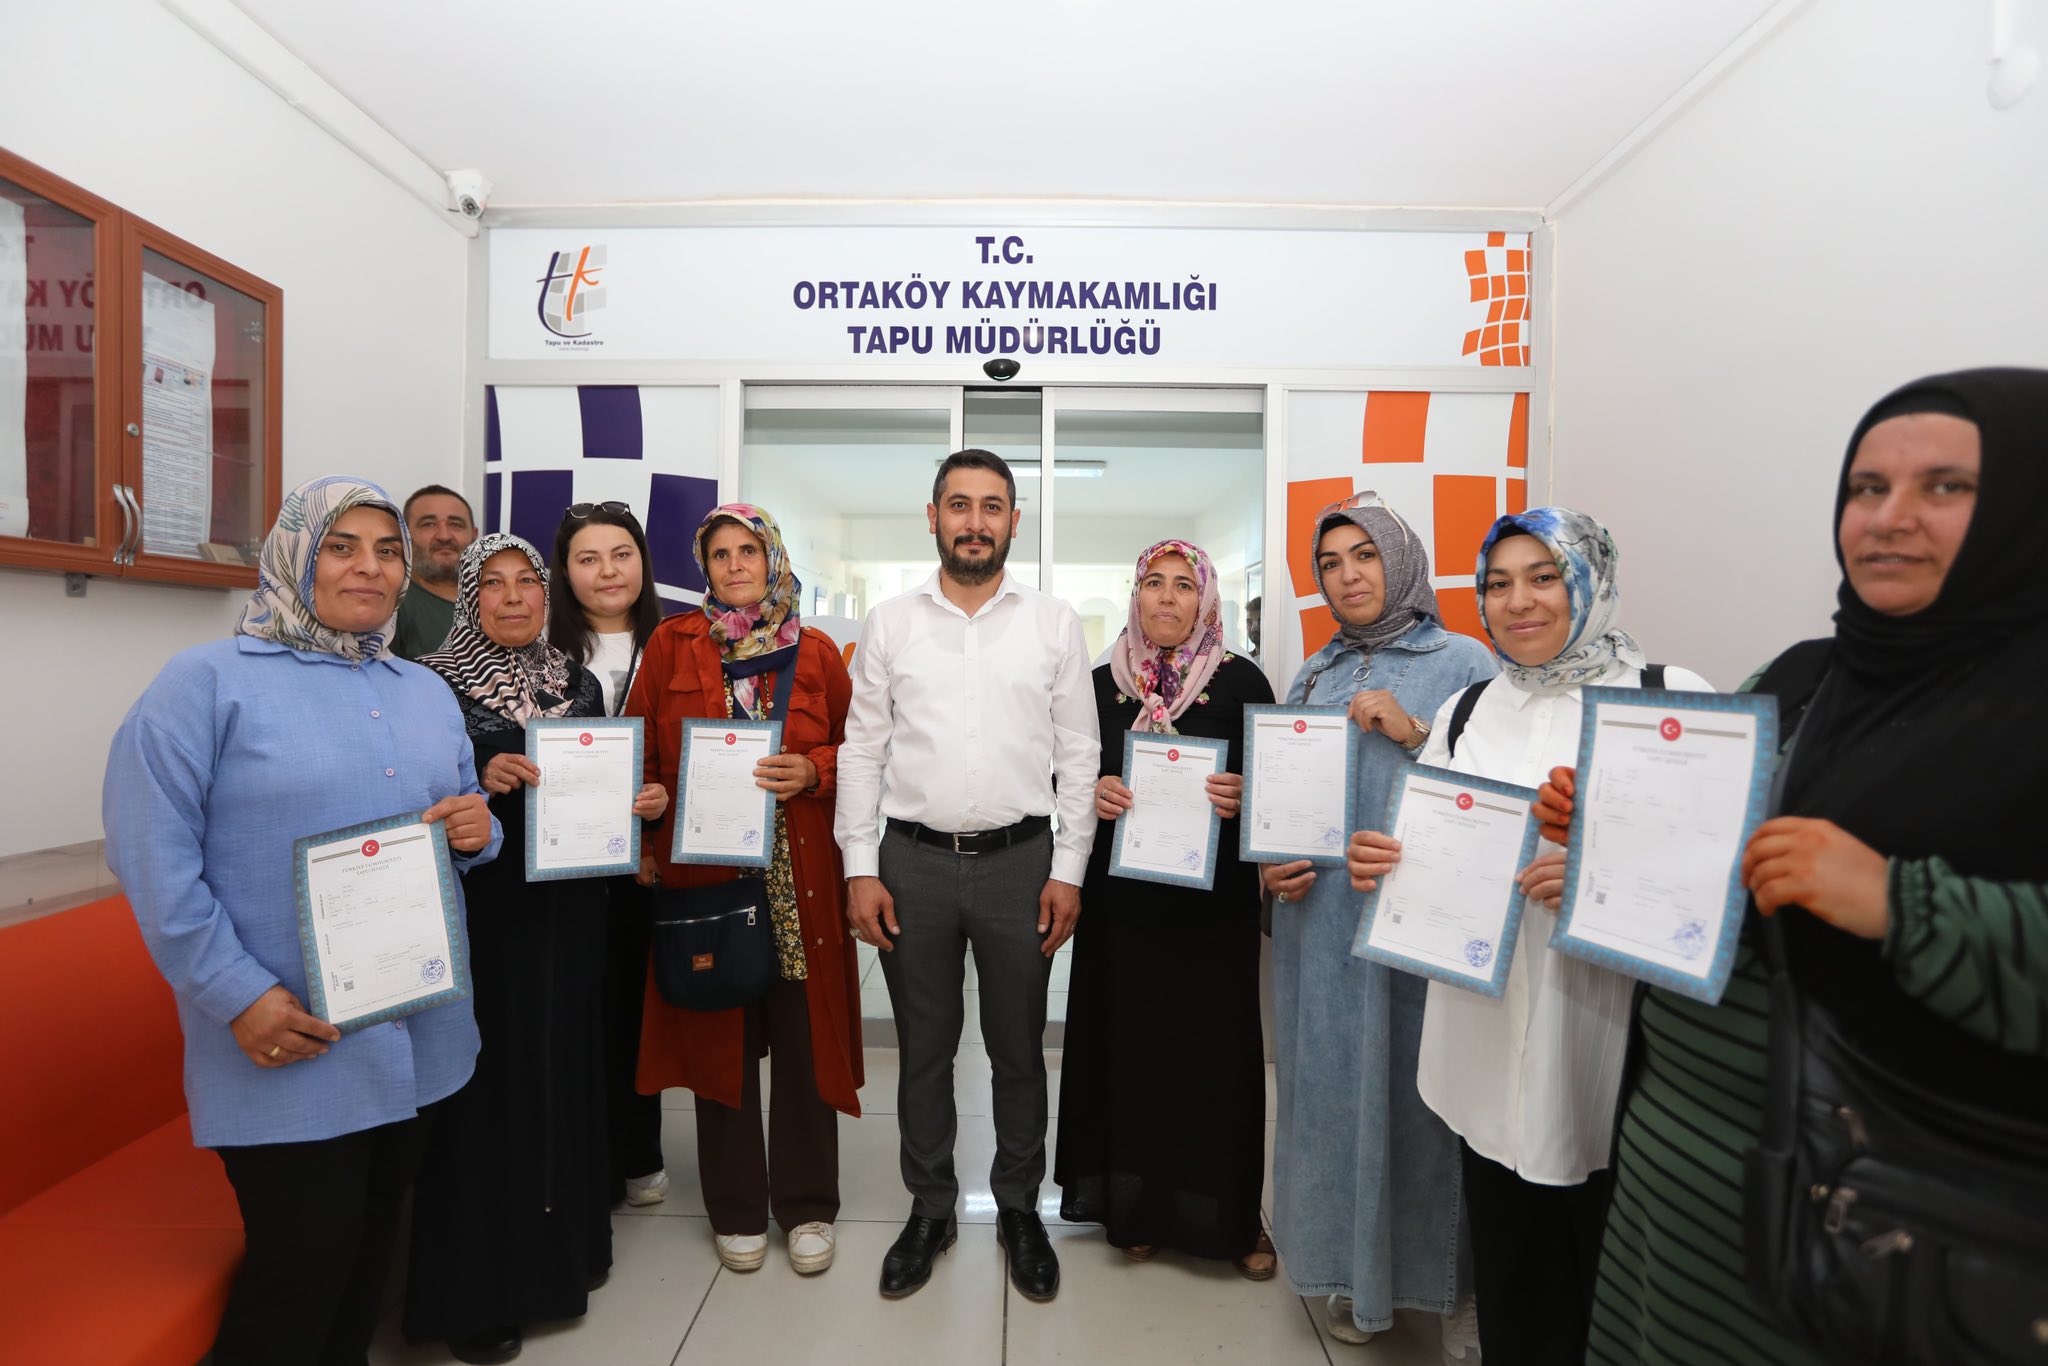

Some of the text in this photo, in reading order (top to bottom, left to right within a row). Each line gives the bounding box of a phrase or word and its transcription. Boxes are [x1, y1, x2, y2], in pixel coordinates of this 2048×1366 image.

[976, 236, 1033, 264] T.C.
[793, 274, 1217, 311] ORTAKÖY KAYMAKAMLIĞI
[848, 318, 1161, 354] TAPU MÜDÜRLÜĞÜ
